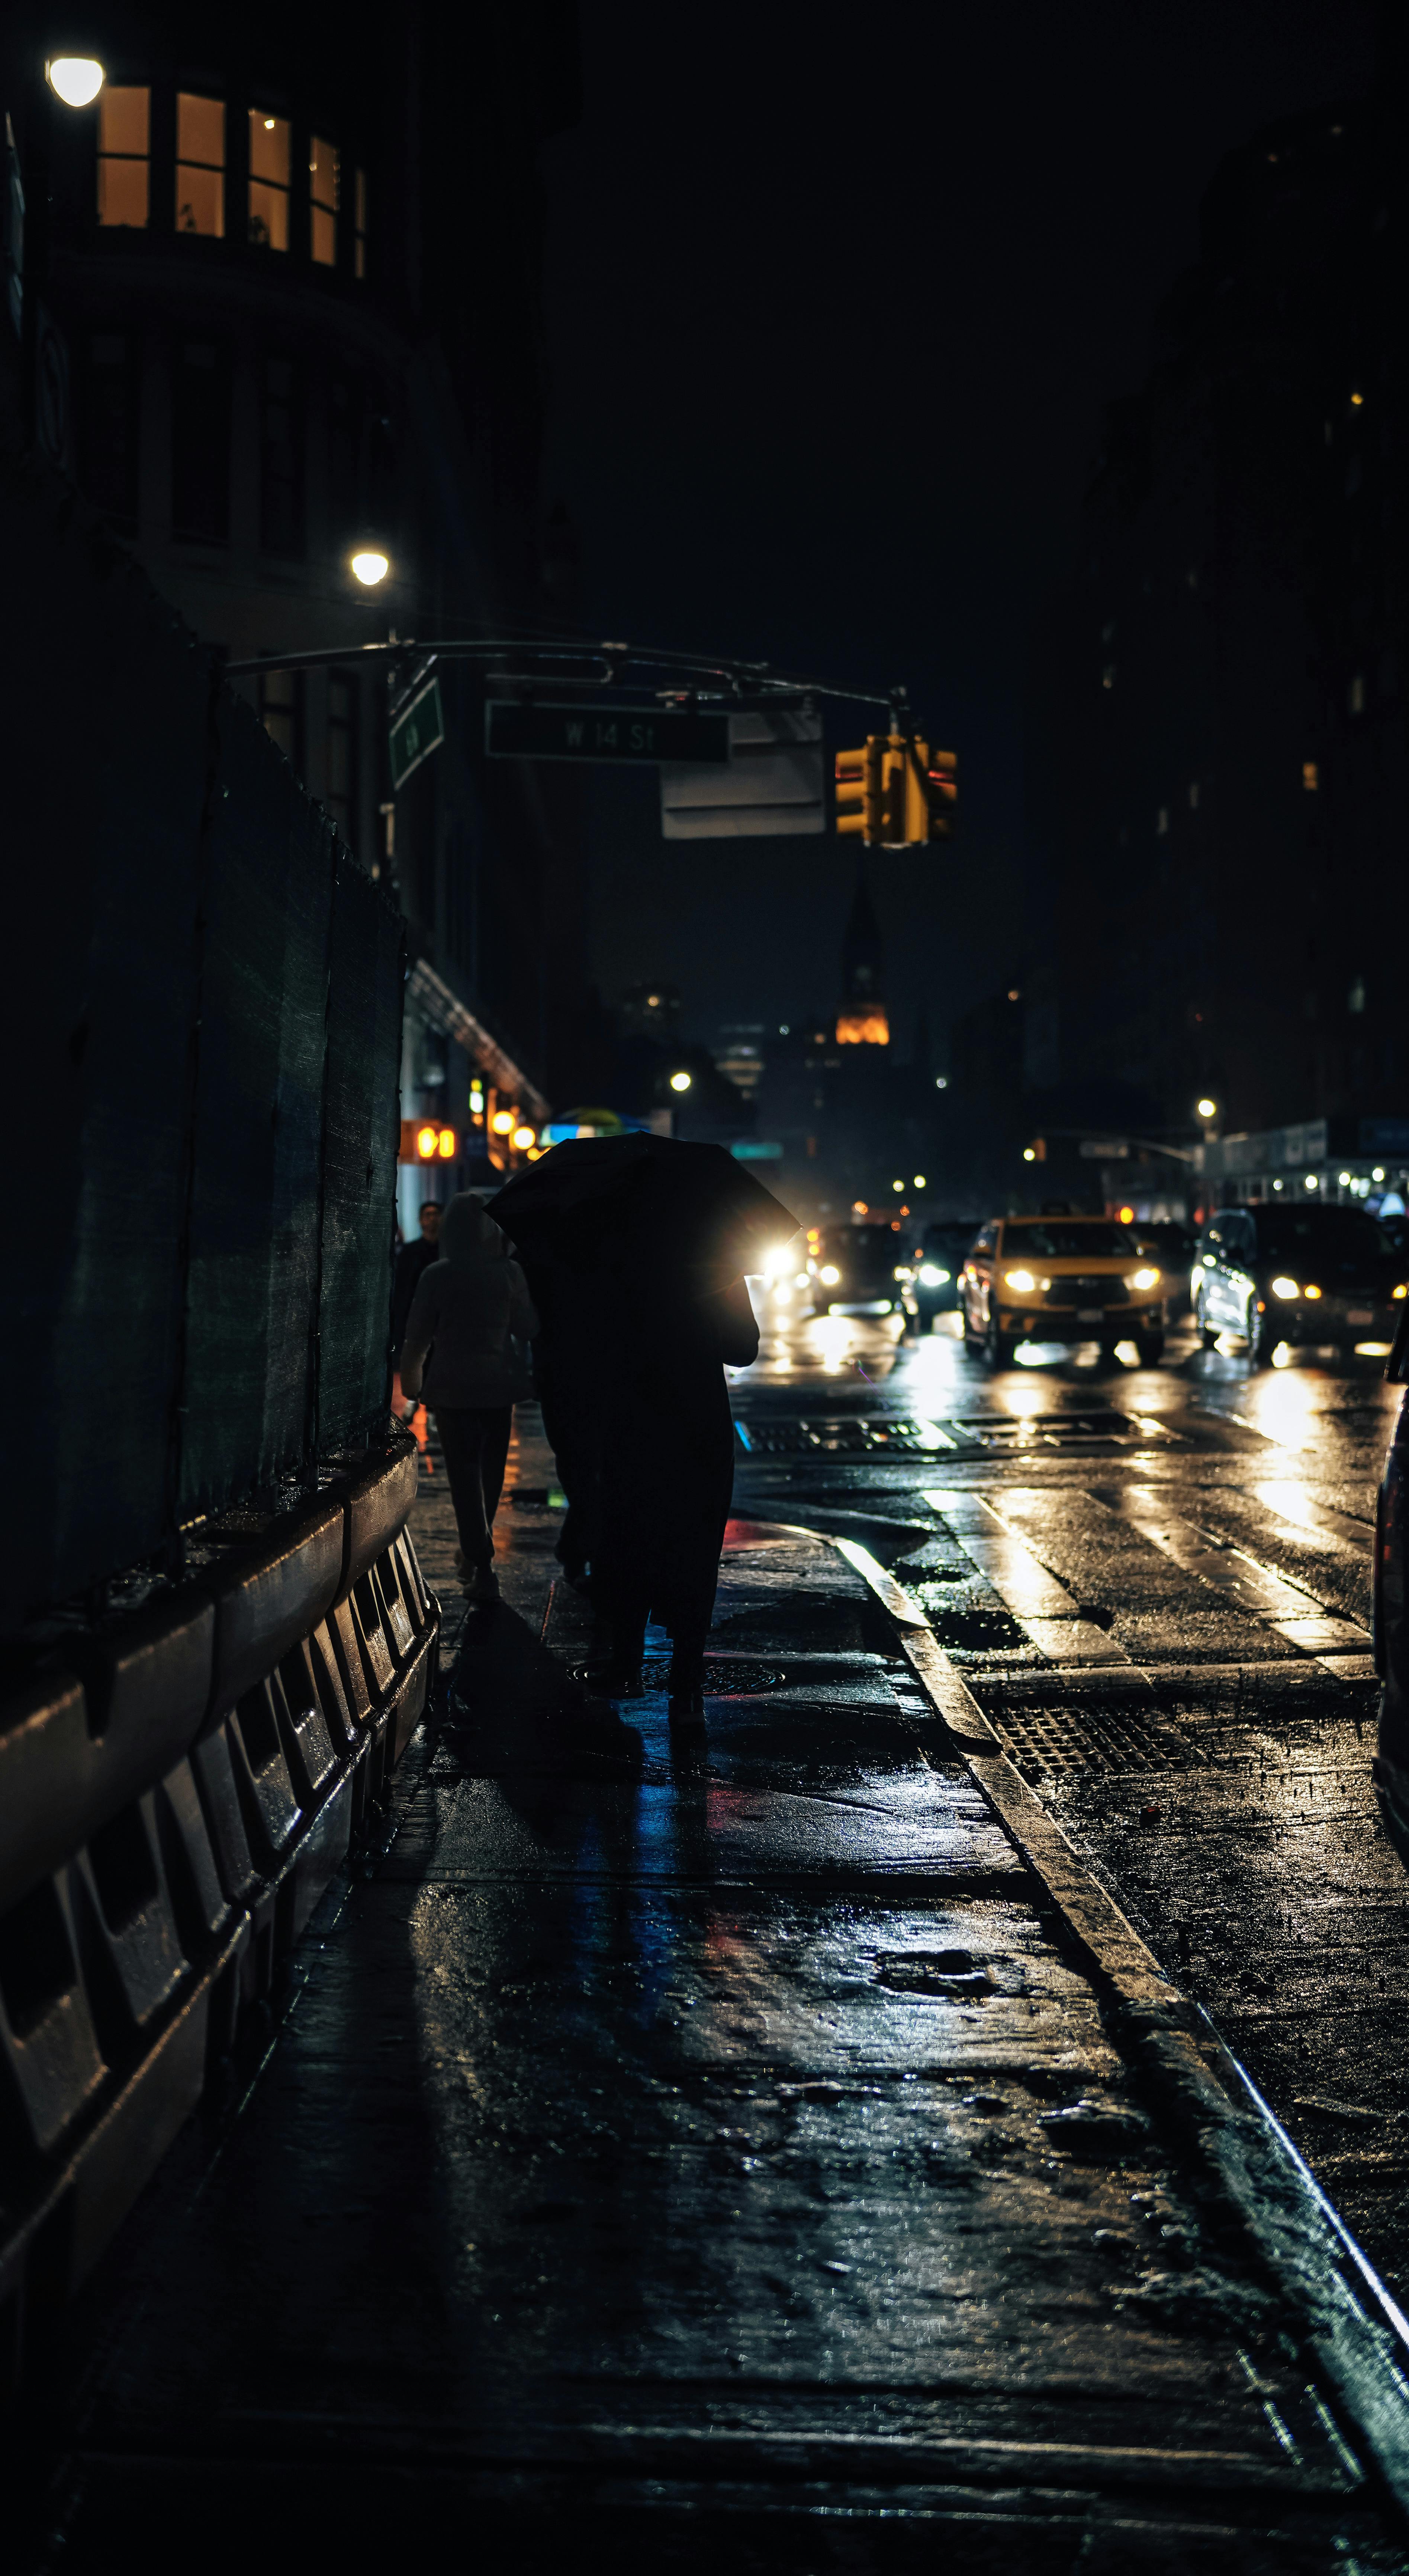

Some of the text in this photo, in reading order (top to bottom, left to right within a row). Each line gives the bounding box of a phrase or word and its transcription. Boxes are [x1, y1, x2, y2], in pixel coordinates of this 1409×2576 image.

[565, 722, 654, 751] W 14 St
